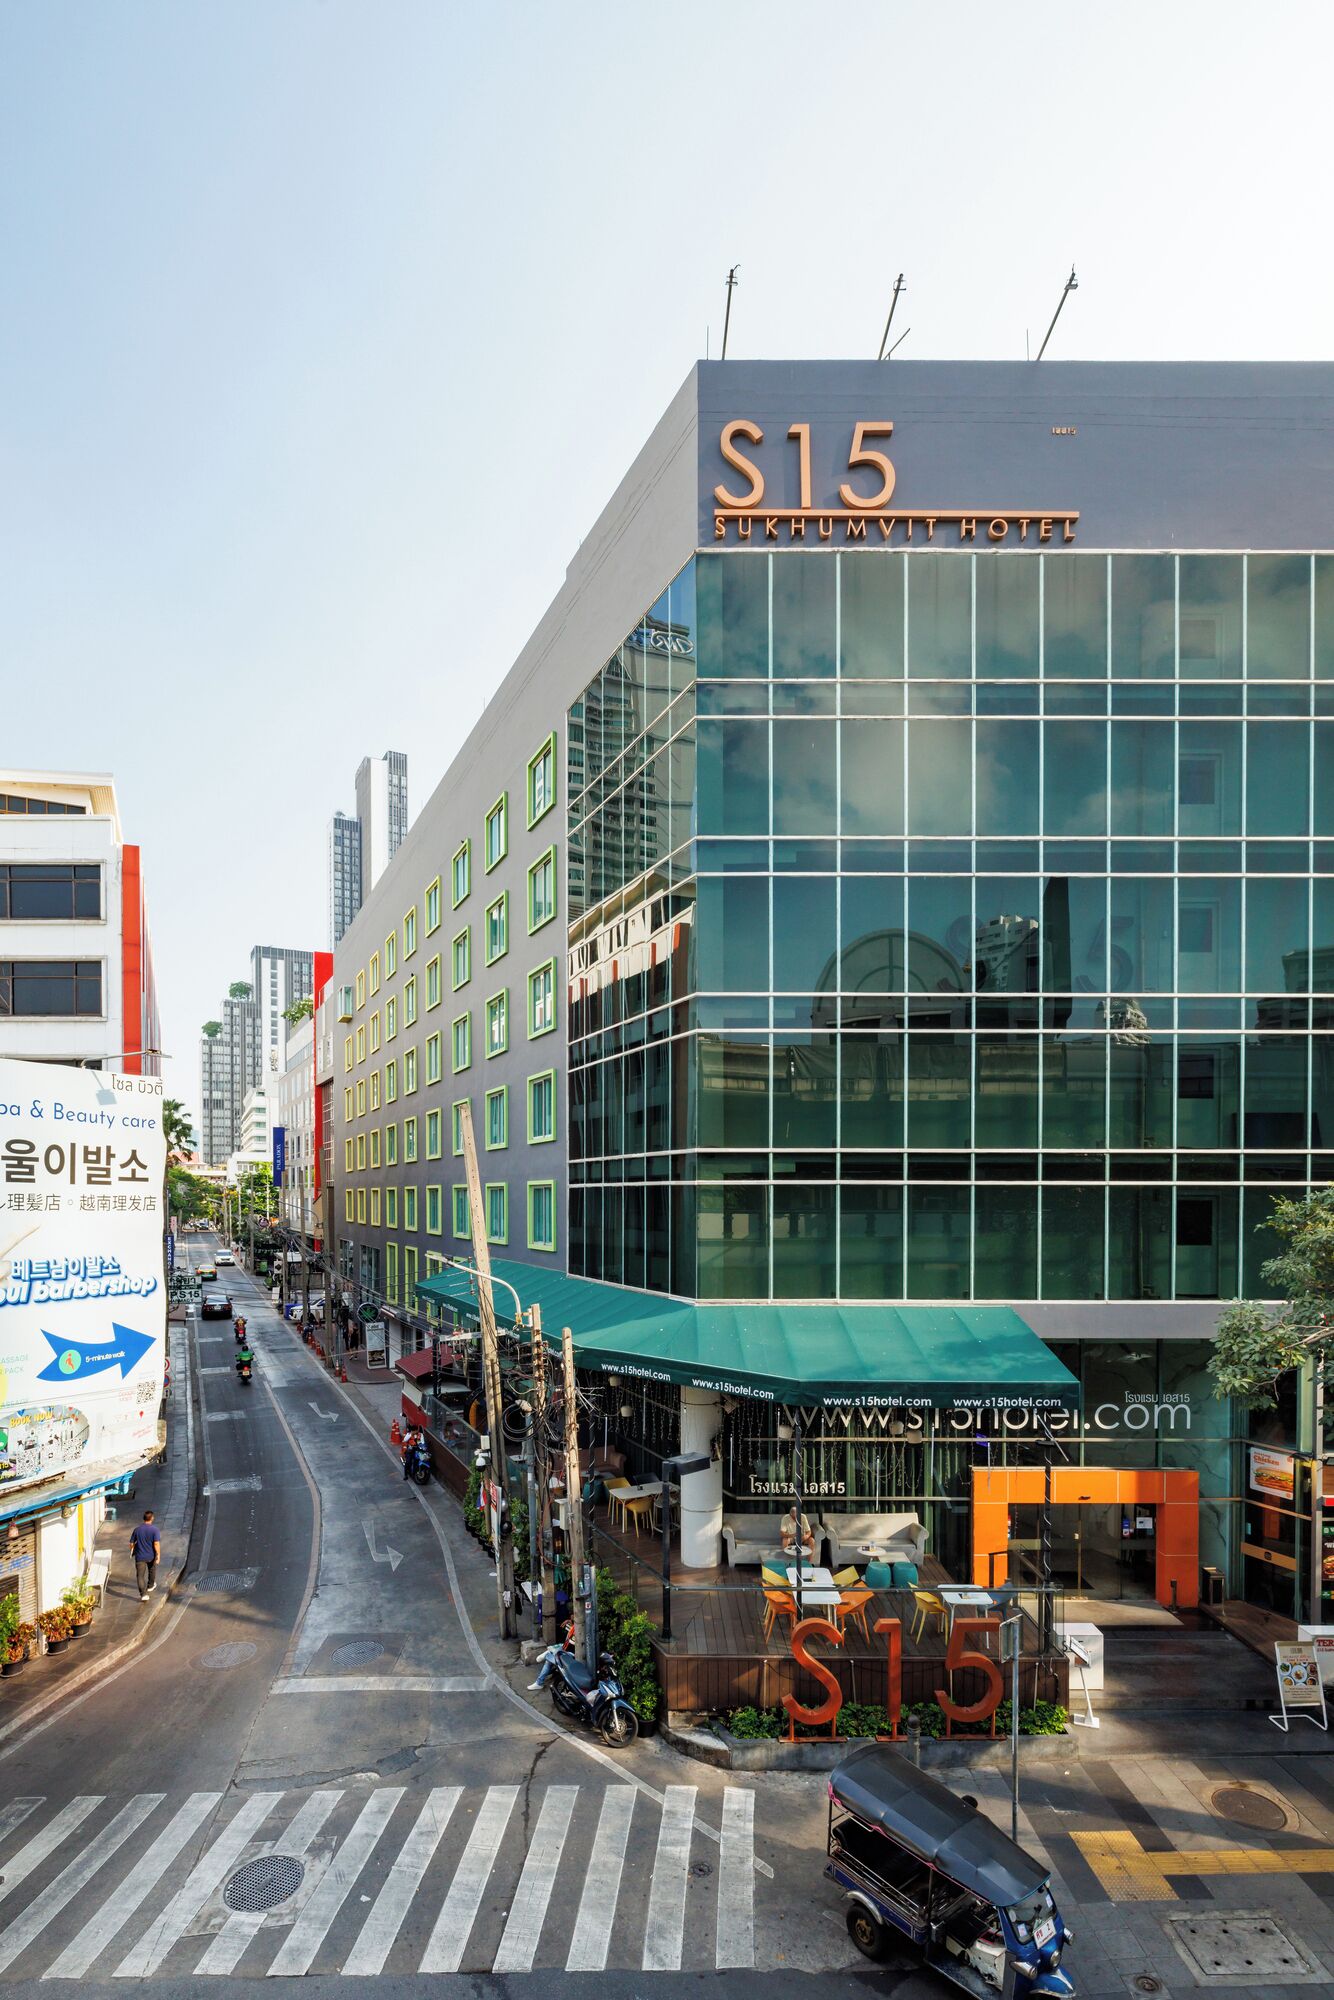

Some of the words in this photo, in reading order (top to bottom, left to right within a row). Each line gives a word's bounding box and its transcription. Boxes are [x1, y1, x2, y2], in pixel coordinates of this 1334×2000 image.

[713, 419, 896, 511] S15
[714, 516, 937, 541] SUKHUMVIT
[960, 518, 1076, 542] HOTEL
[111, 1073, 133, 1092] โซล
[30, 1099, 44, 1119] &
[54, 1102, 116, 1129] Beauty
[122, 1115, 156, 1129] care
[1, 1138, 150, 1186] 울이발소
[79, 1195, 157, 1212] 越南理发店
[34, 1275, 157, 1303] barbershop
[601, 1362, 671, 1382] www.s15hotel.com
[692, 1377, 774, 1400] www.s15hotel.com
[1125, 1390, 1158, 1403] โรงแรม
[1163, 1393, 1191, 1403] เอส15
[823, 1396, 932, 1407] www.s15hotel.com
[953, 1396, 1062, 1408] www.s15hotel.com
[804, 1481, 845, 1494] เอส15
[782, 1617, 1005, 1726] S15
